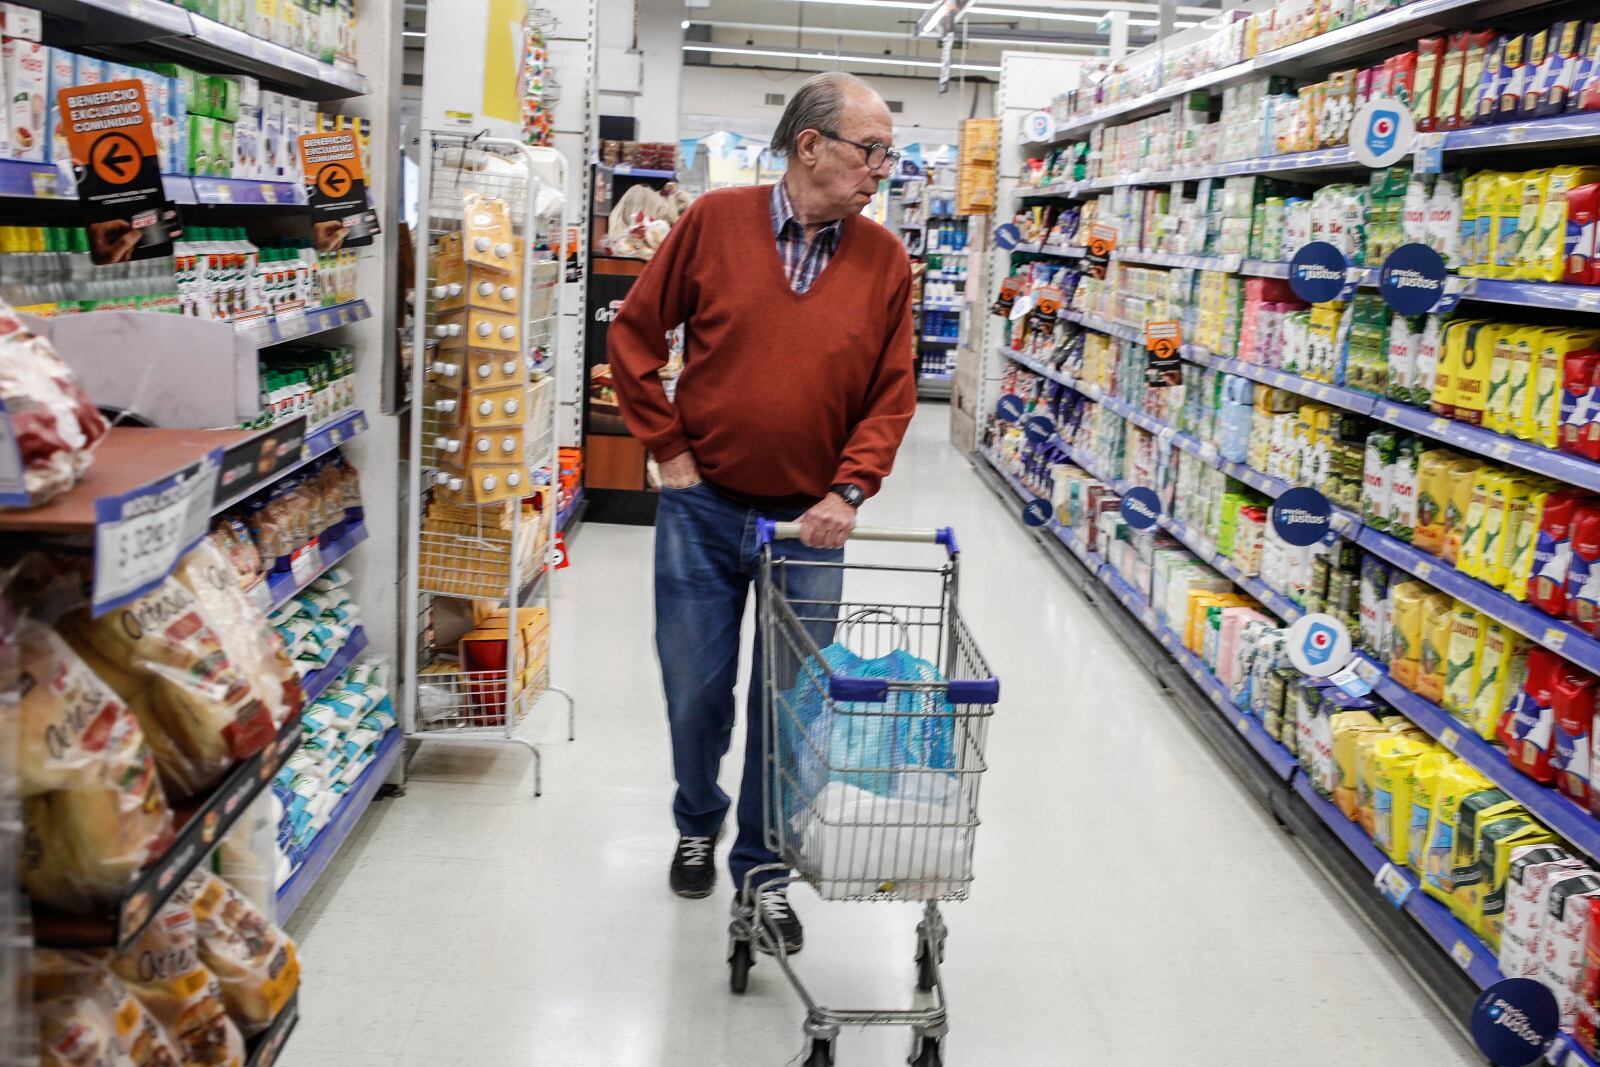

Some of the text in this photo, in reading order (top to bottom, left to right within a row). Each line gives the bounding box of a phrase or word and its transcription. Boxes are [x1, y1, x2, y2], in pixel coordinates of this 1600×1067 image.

[67, 88, 139, 108] BENEFICIO
[70, 102, 141, 121] EXCLUSIVO
[73, 115, 144, 133] COMUNIDAD
[303, 135, 353, 148] BENEFICIO
[305, 144, 354, 156] EXCLUSIVO
[307, 152, 356, 164] COMUNIDAD
[1397, 275, 1439, 289] justos
